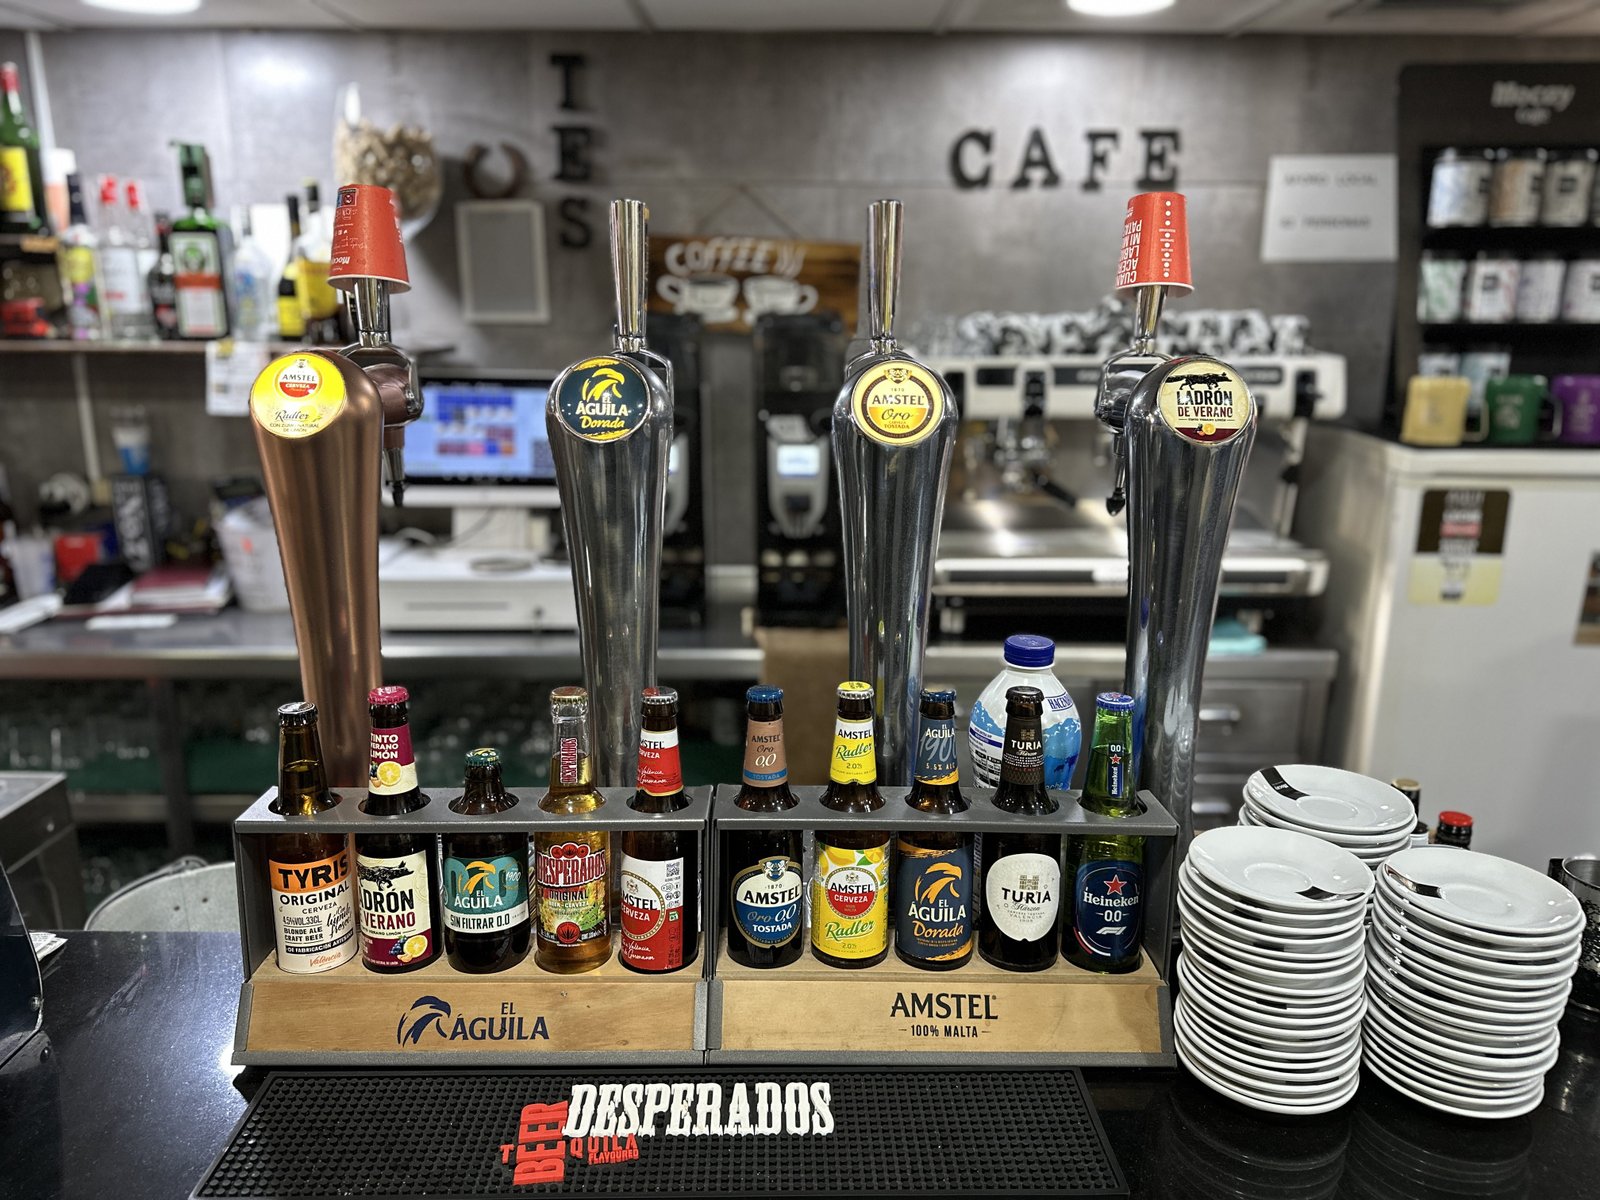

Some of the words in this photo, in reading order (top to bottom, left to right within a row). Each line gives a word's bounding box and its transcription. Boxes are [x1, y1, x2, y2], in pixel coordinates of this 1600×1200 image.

[664, 237, 771, 277] COFFEE
[282, 374, 316, 382] AMSTEL
[872, 394, 925, 406] AMSTEL
[1176, 388, 1233, 406] LADRÓN
[275, 409, 310, 422] Radler
[575, 401, 629, 416] ÁGUILA
[881, 408, 911, 421] Oro
[1177, 406, 1190, 417] DE
[1193, 406, 1233, 418] VERANO
[579, 415, 626, 428] Dorada
[370, 732, 399, 743] TINTO
[751, 735, 781, 743] AMSTEL
[837, 728, 873, 740] AMSTEL
[756, 745, 774, 753] Oro
[835, 742, 873, 761] Radler
[1011, 739, 1042, 750] TURIA
[370, 748, 399, 760] LIMÓN
[560, 737, 577, 784] DESPERADOS
[752, 773, 781, 781] TOSTADA
[277, 854, 350, 890] TYRIS
[536, 850, 607, 886] DESPERADOS
[505, 871, 522, 882] 1900
[279, 880, 350, 906] ORIGINAL
[743, 884, 800, 905] AMSTEL
[830, 882, 874, 895] AMSTEL
[1001, 887, 1052, 904] TURIA
[454, 894, 503, 909] ÁGUILA
[833, 894, 869, 903] CERVEZA
[938, 899, 949, 907] EL
[1083, 890, 1139, 908] Heineken
[301, 901, 338, 915] CERVEZA
[908, 901, 967, 922] ÁGUILA
[363, 911, 416, 930] VERANO
[450, 914, 461, 928] SIN
[462, 916, 494, 930] FILTRAR
[496, 913, 510, 927] 0.0
[747, 911, 772, 923] Oro
[283, 927, 307, 935] BLONDE
[309, 926, 323, 934] ALE
[752, 921, 793, 933] TOSTADA
[825, 920, 874, 942] Radler
[912, 920, 964, 938] Dorada
[284, 934, 303, 942] CRAFT
[305, 933, 324, 941] BEER
[501, 1001, 516, 1015] EL
[890, 992, 999, 1020] AMSTEL
[449, 1013, 550, 1041] ÁGUILA
[911, 1024, 939, 1037] 100%
[944, 1025, 978, 1038] MALTA
[561, 1082, 834, 1138] DESPERADOS
[513, 1100, 568, 1186] BEER
[588, 1148, 639, 1166] FLAVOURED
